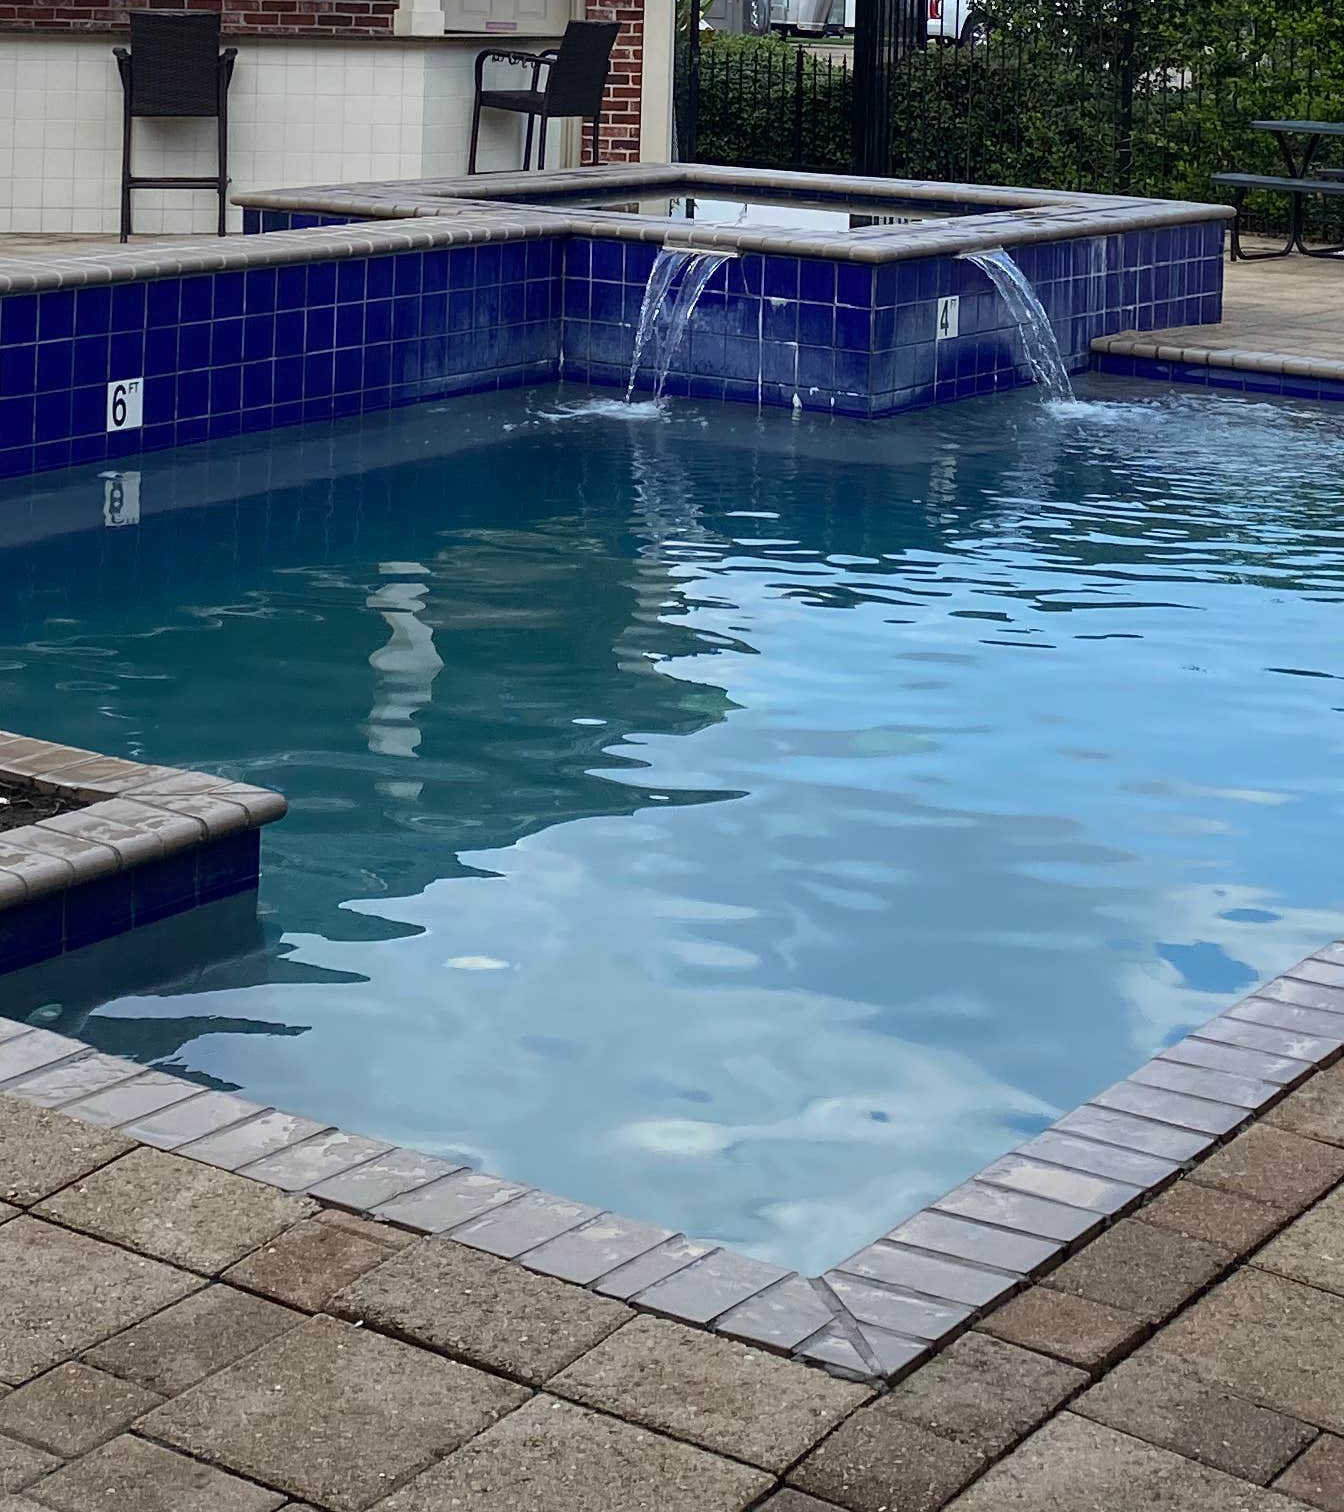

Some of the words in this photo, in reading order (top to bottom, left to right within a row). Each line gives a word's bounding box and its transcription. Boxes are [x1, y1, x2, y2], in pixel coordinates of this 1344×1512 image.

[940, 299, 949, 336] 4
[112, 384, 127, 427] 6
[128, 381, 139, 393] FT
